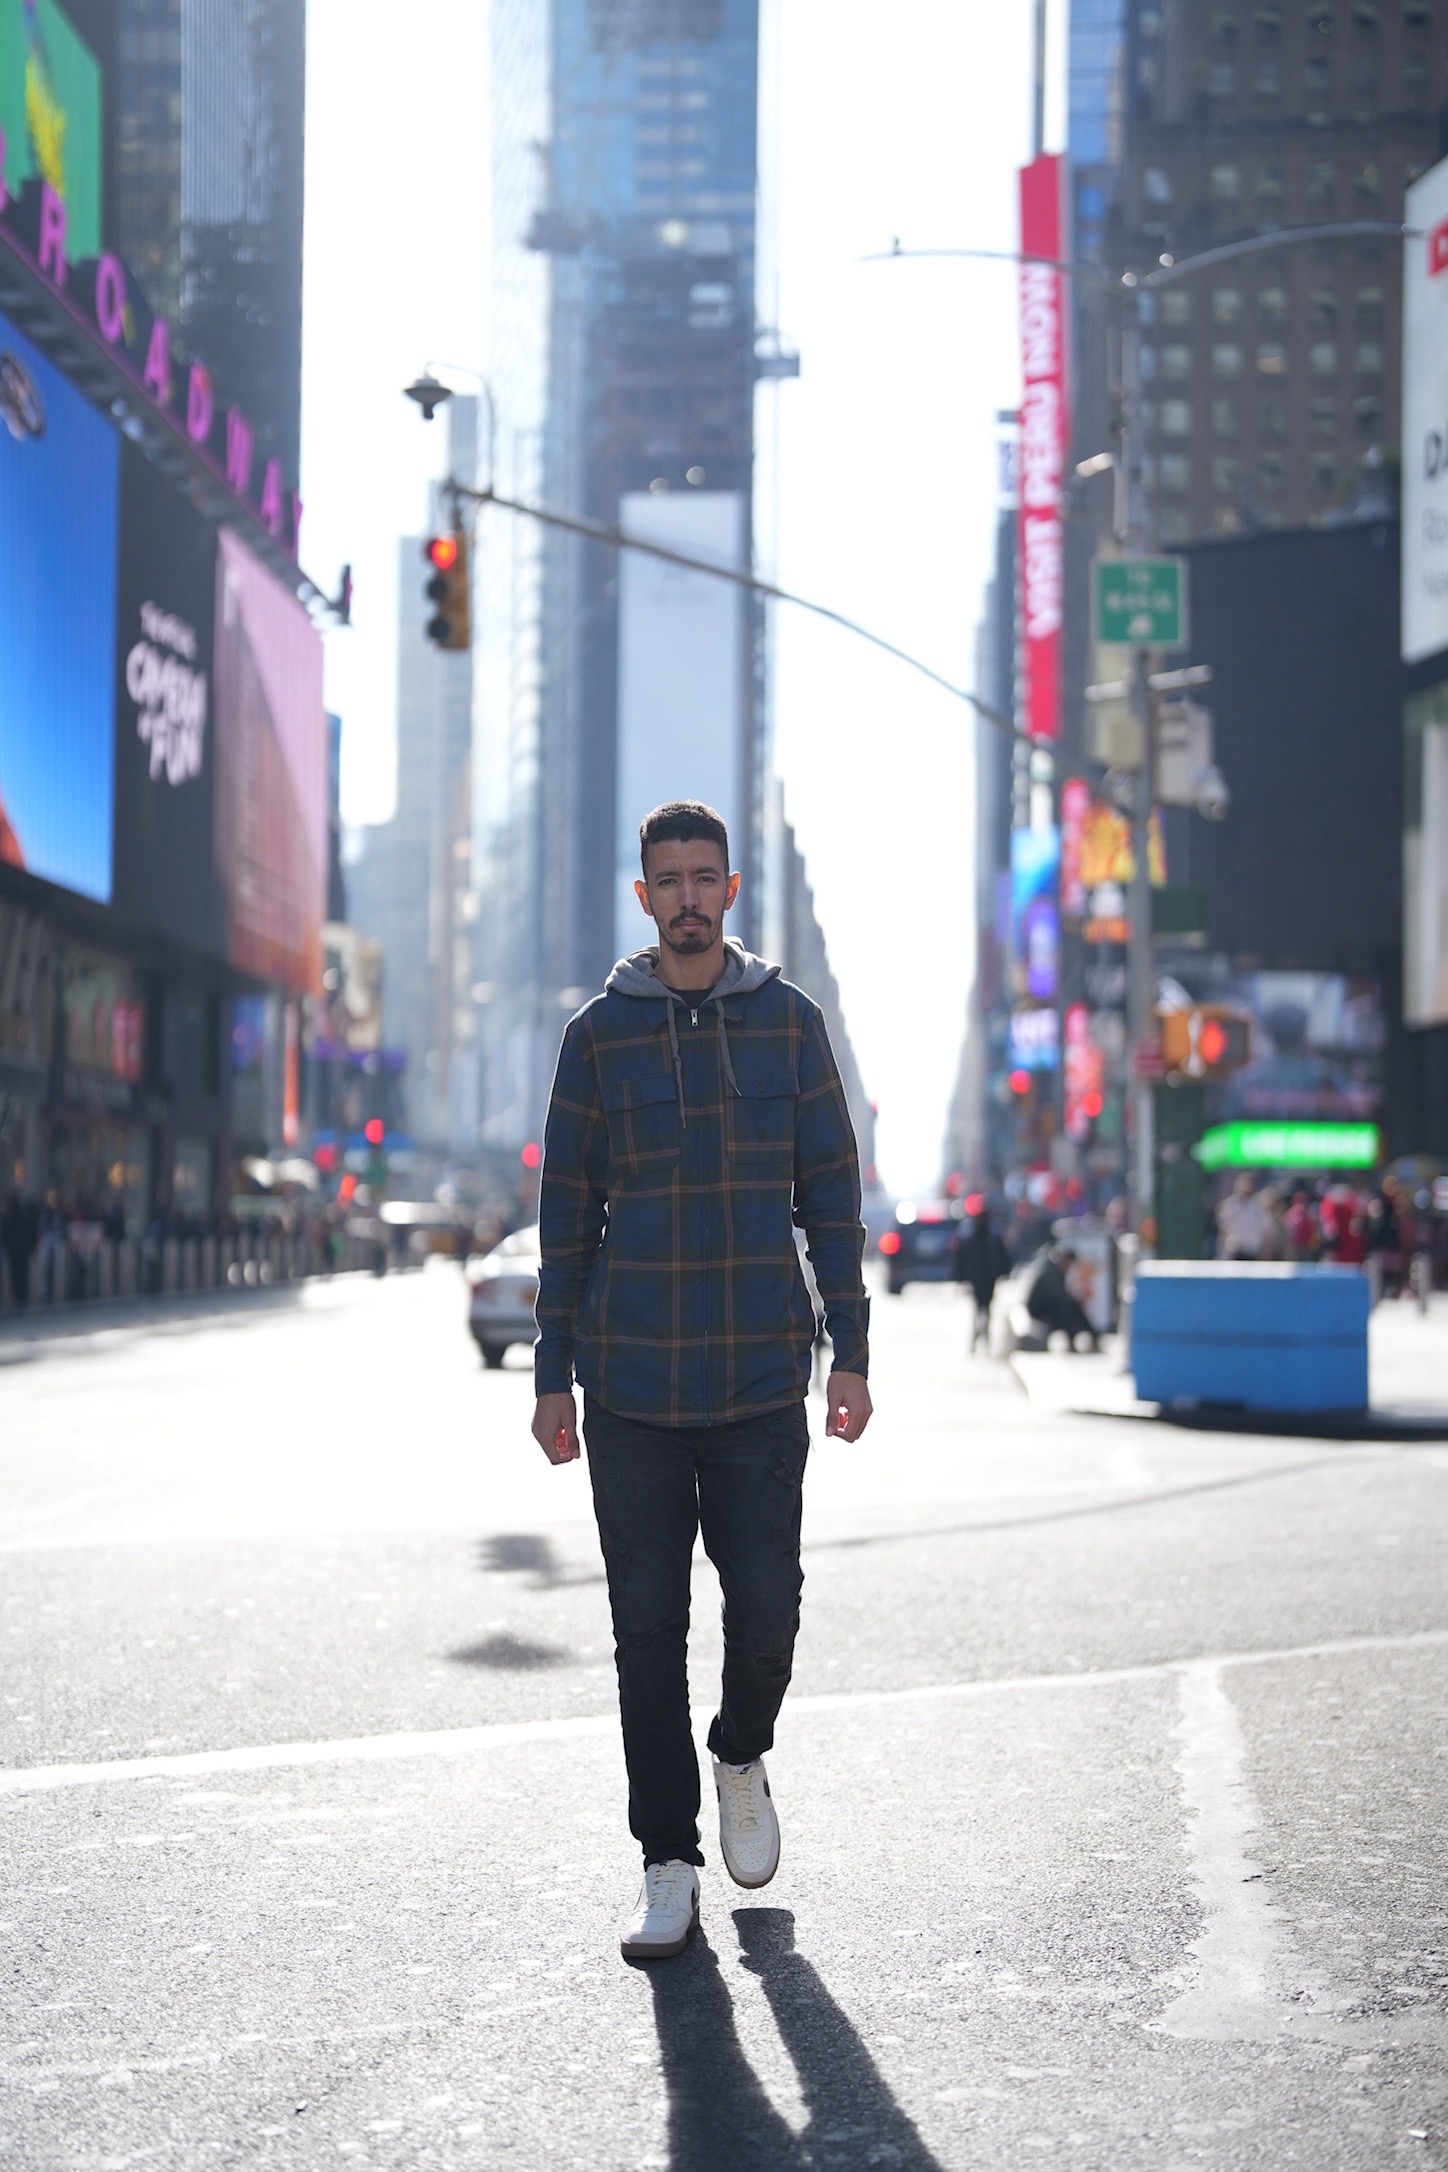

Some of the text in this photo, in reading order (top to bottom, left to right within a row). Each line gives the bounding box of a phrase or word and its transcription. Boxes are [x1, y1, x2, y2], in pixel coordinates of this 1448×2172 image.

[1020, 261, 1062, 640] VISIT PERU NOW
